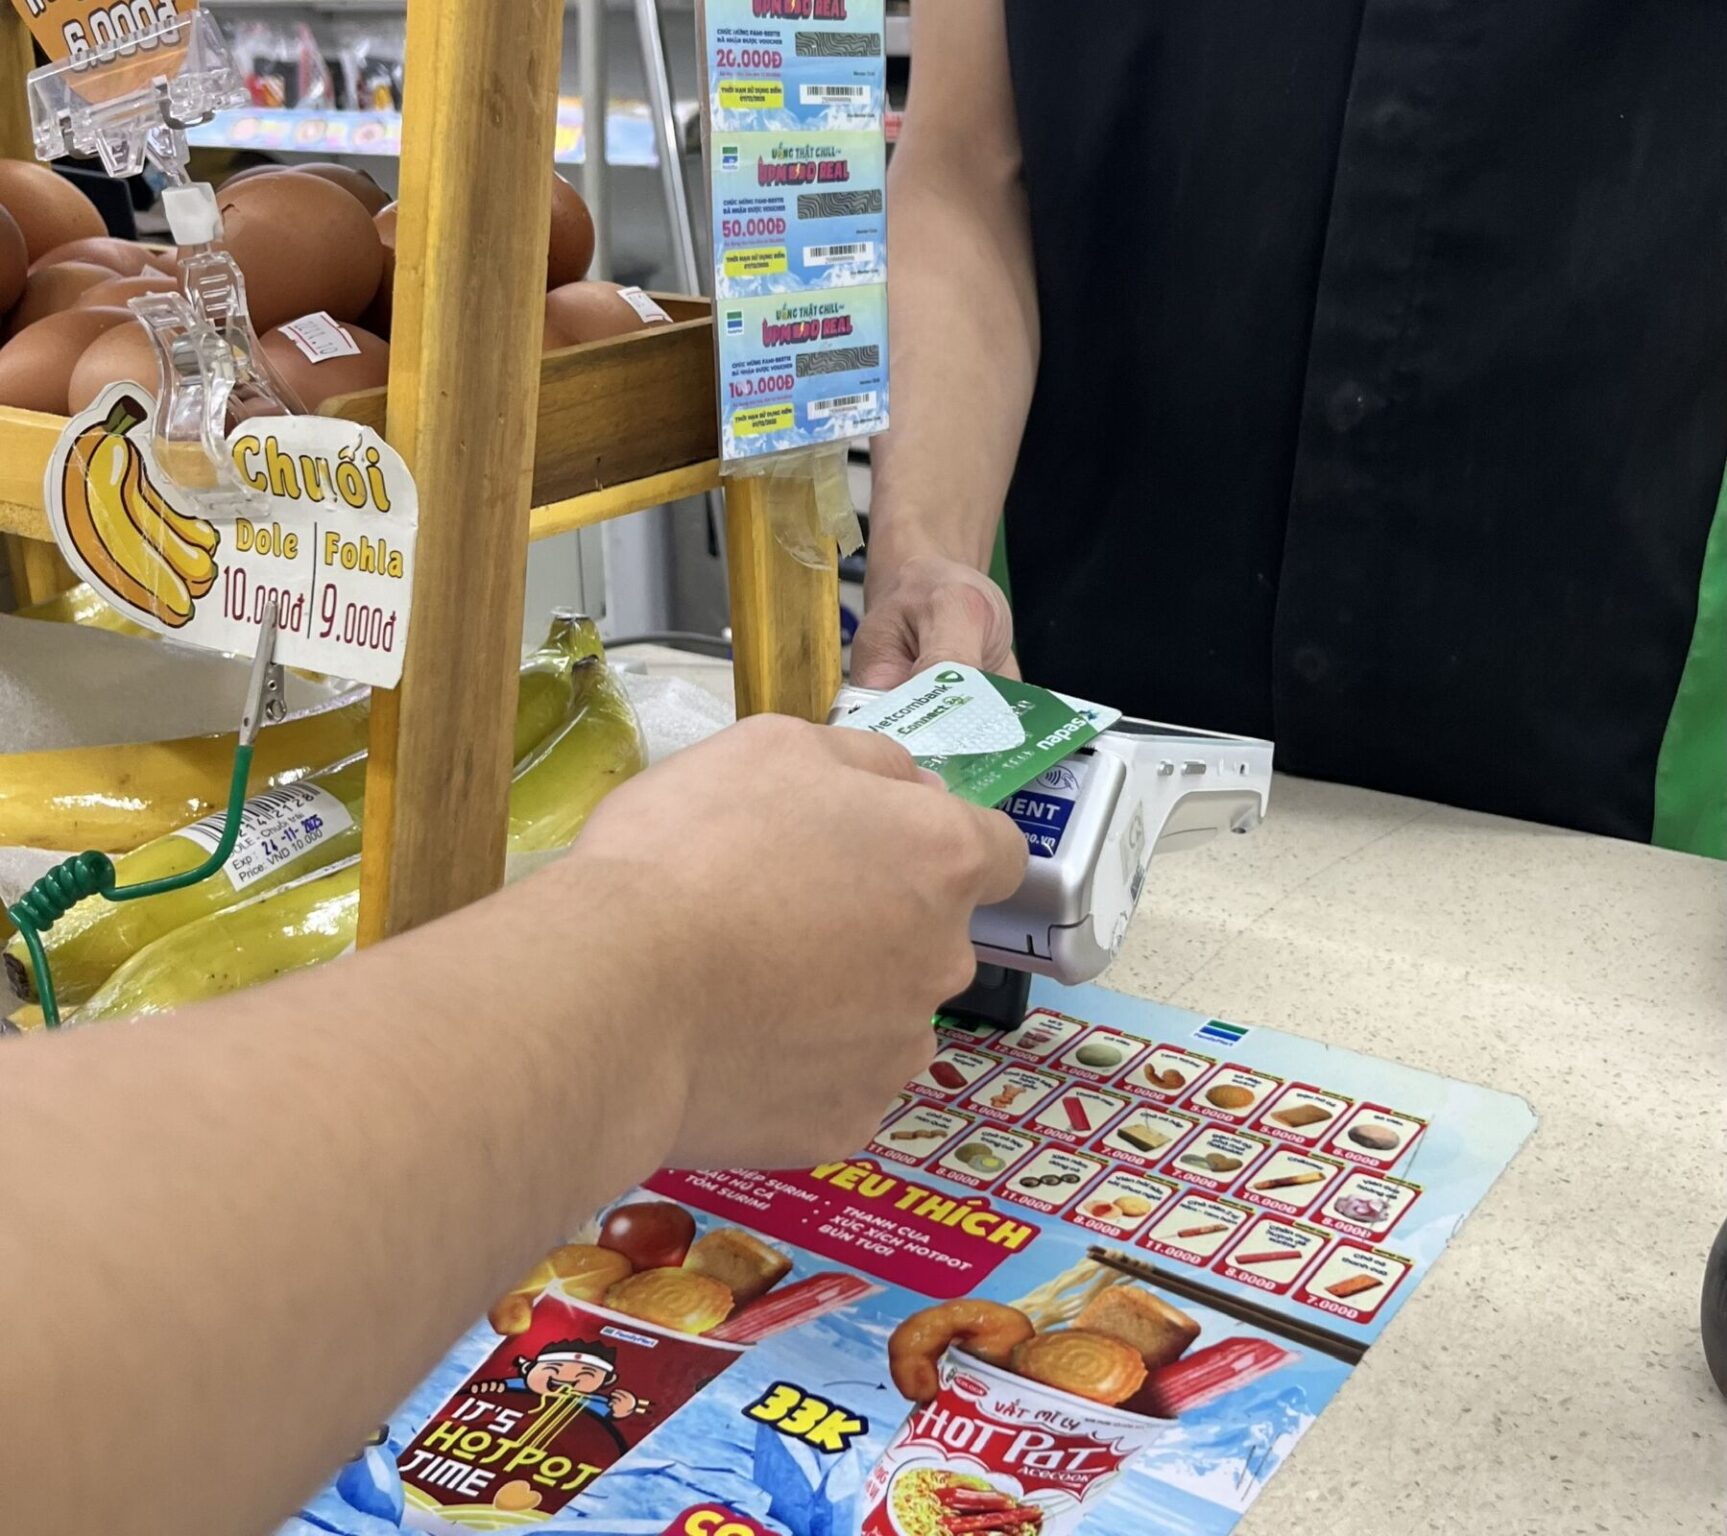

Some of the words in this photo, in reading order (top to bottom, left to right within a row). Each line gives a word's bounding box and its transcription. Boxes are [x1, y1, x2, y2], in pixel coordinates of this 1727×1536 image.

[722, 217, 786, 238] 50.000Đ
[232, 433, 391, 512] Chuối
[236, 517, 299, 559] Dole
[325, 531, 404, 578] Fohla
[320, 583, 397, 652] 9.000đ
[897, 704, 950, 736] Connect
[1036, 717, 1087, 751] napas
[266, 847, 291, 865] VND
[292, 829, 323, 851] 10.000
[716, 1187, 772, 1211] SURIMI
[764, 1178, 820, 1202] SURIMI
[843, 1206, 897, 1231] THANH
[897, 1226, 931, 1243] CUA
[893, 1185, 1032, 1250] THÍCH
[903, 1242, 973, 1271] HOTPOT
[450, 1396, 525, 1435] IT'S
[745, 1382, 865, 1452] 33K
[915, 1400, 1018, 1454] HOT
[398, 1449, 497, 1499] TIME
